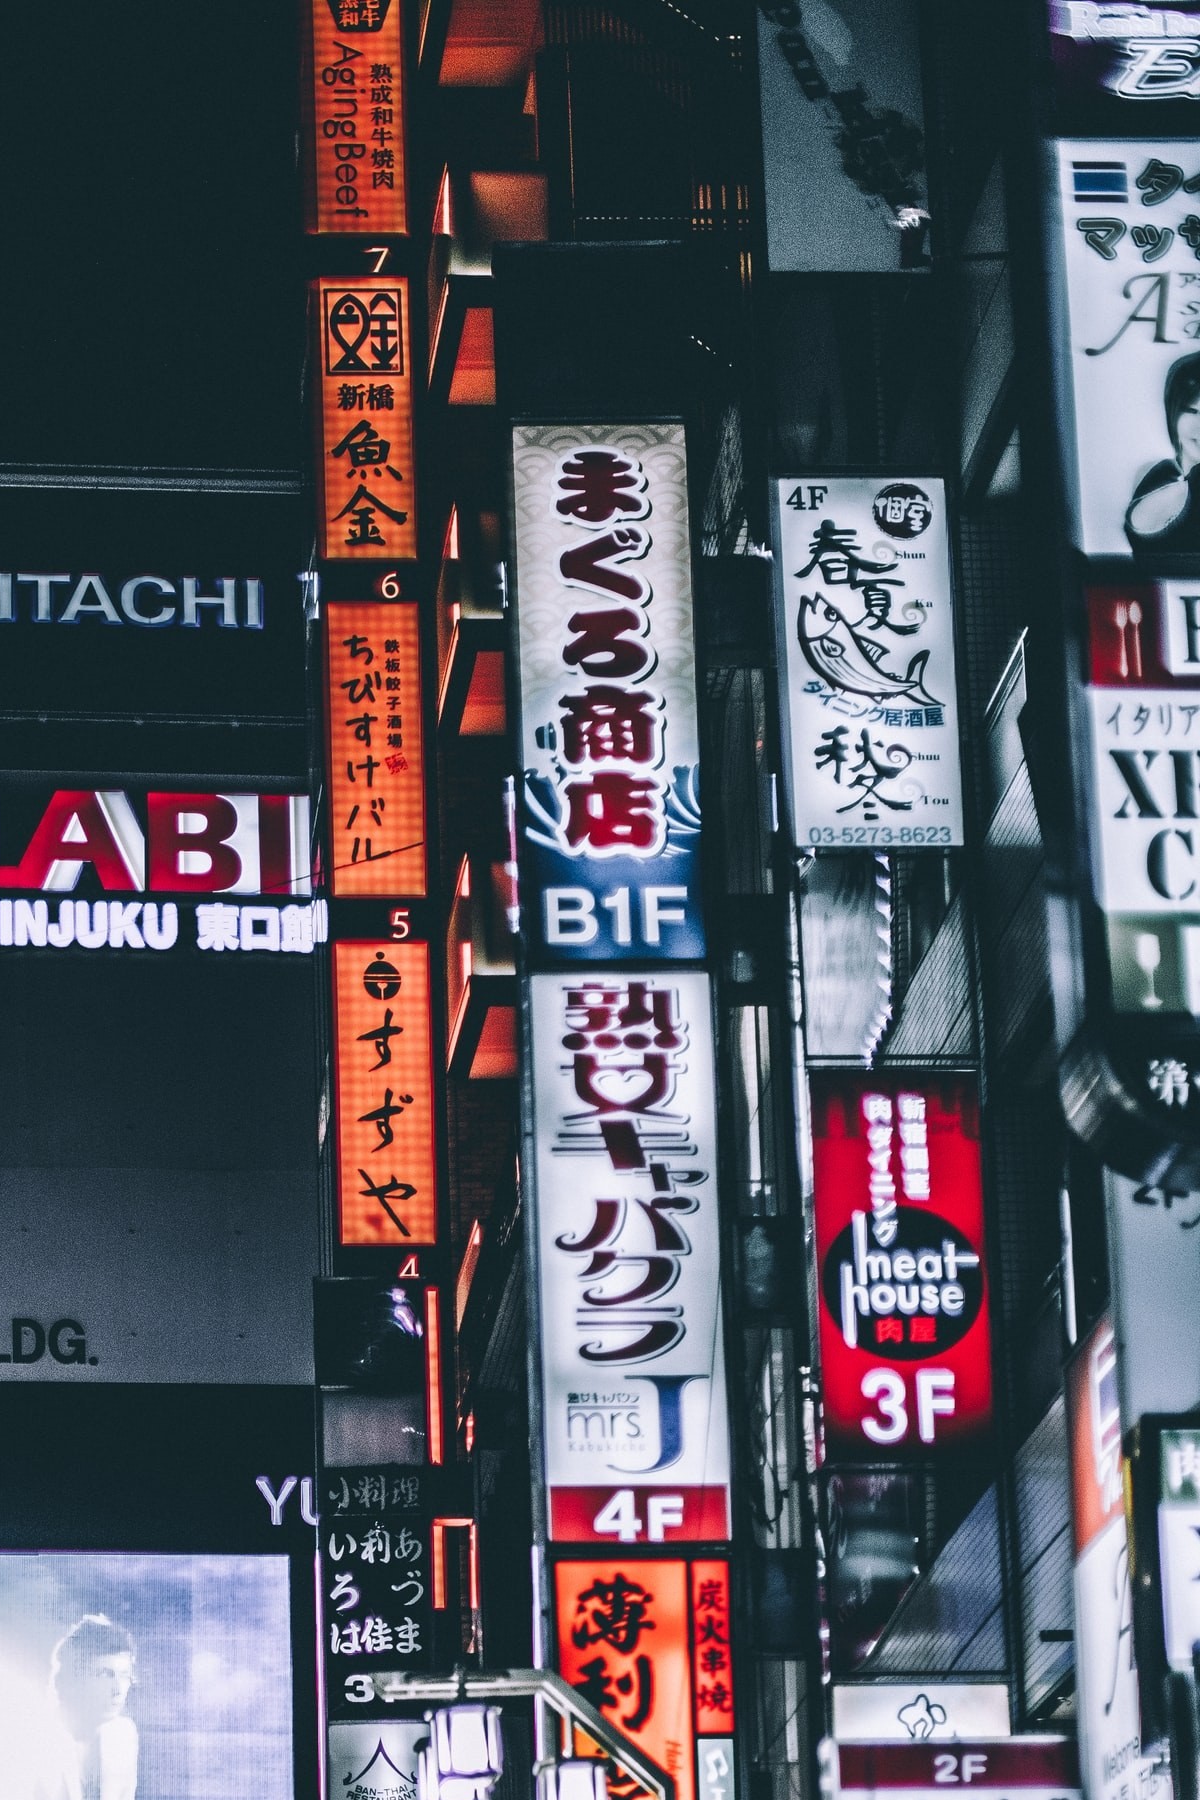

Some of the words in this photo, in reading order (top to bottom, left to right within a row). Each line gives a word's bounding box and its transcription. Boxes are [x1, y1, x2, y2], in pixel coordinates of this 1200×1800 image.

[369, 63, 395, 191] 熟成和牛焼肉
[363, 247, 390, 273] 7
[336, 383, 395, 412] 新橋
[330, 418, 409, 547] 魚金
[786, 485, 829, 511] 4F
[380, 572, 400, 600] 6
[555, 446, 668, 857] まぐろ商店
[384, 639, 403, 749] 鉄板餃子酒場
[340, 634, 393, 864] ちびすけバル
[809, 826, 953, 845] 03-5273-8623
[391, 911, 410, 939] 5
[544, 885, 688, 947] B1F
[356, 1007, 418, 1238] すずや
[851, 1209, 980, 1286] meat
[840, 1262, 966, 1349] house
[875, 1317, 937, 1344] 肉屋
[860, 1367, 956, 1445] 3F
[328, 1474, 421, 1510] 小料理
[592, 1489, 685, 1543] 4F
[354, 1783, 409, 1796] BAN-THAI
[933, 1754, 989, 1784] 2F
